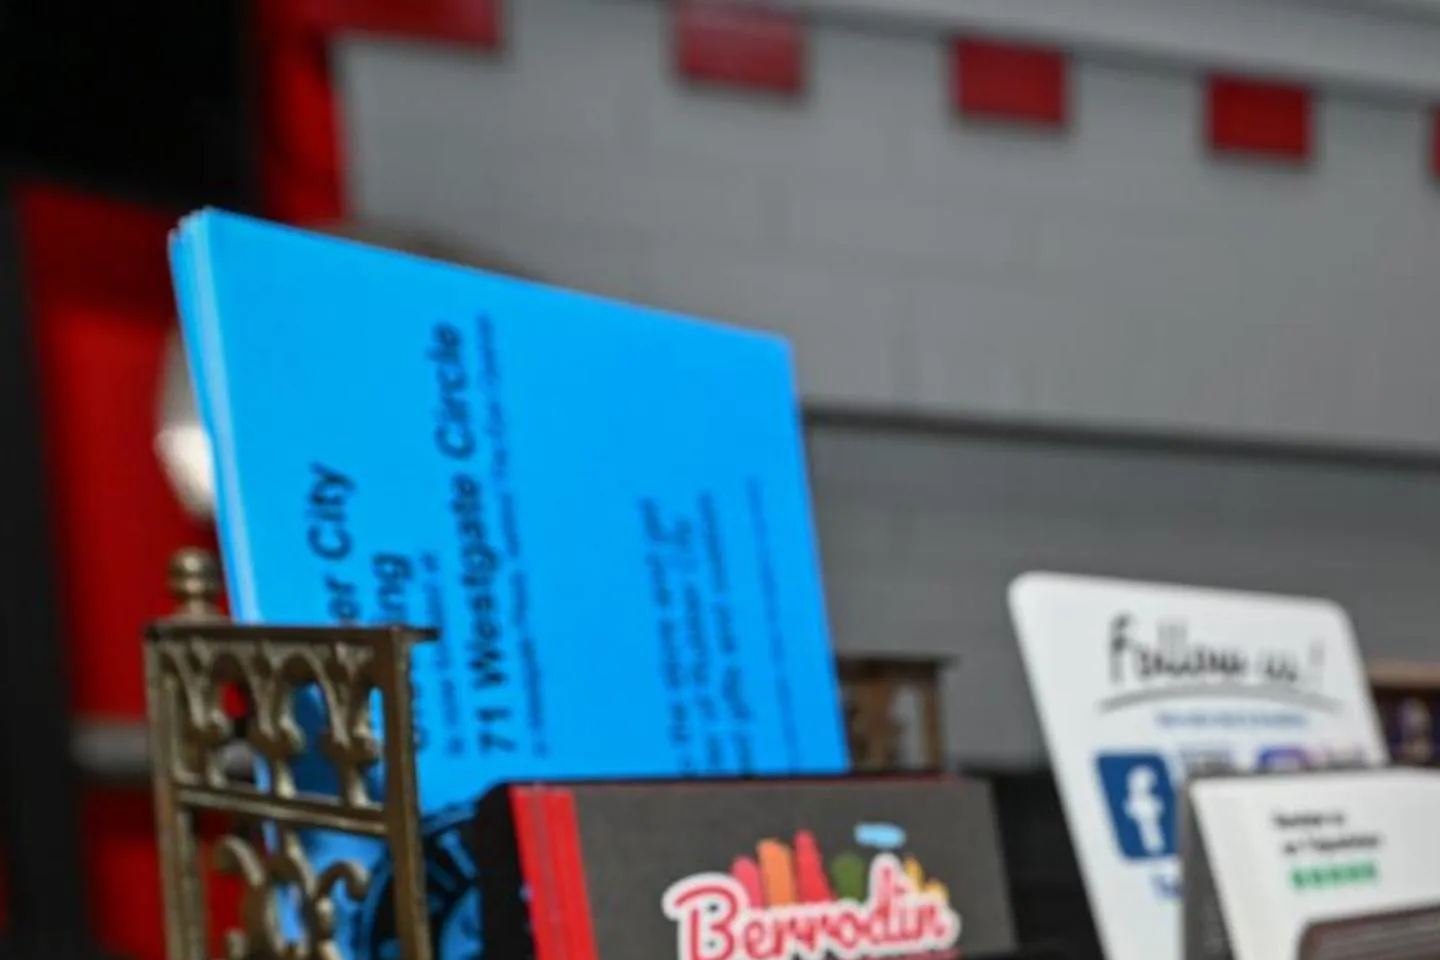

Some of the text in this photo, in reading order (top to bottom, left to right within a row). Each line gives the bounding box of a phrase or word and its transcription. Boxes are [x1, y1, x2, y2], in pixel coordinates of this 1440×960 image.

[426, 320, 477, 461] Circle
[306, 461, 357, 562] City
[450, 472, 508, 692] Westgate
[1108, 613, 1248, 685] Follow
[477, 710, 517, 757] 71
